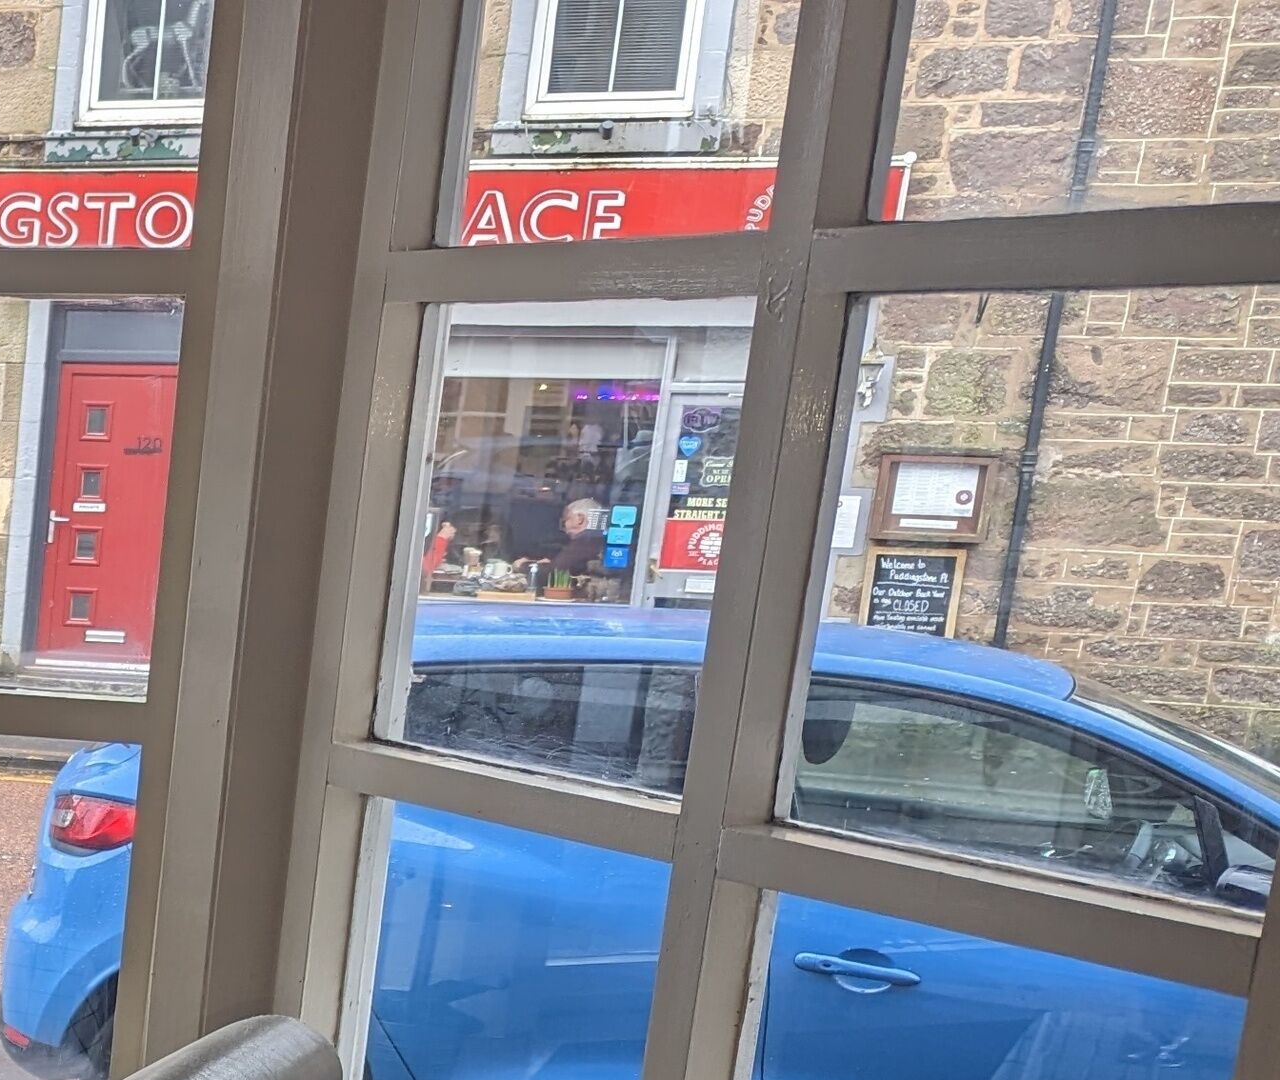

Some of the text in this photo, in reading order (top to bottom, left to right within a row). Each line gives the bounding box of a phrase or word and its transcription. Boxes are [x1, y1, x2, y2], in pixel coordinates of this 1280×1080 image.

[461, 190, 626, 247] ACE
[687, 497, 715, 507] MORE
[673, 509, 719, 519] STRAIGHT
[880, 557, 926, 570] Welcome to
[892, 599, 930, 613] CLOSED
